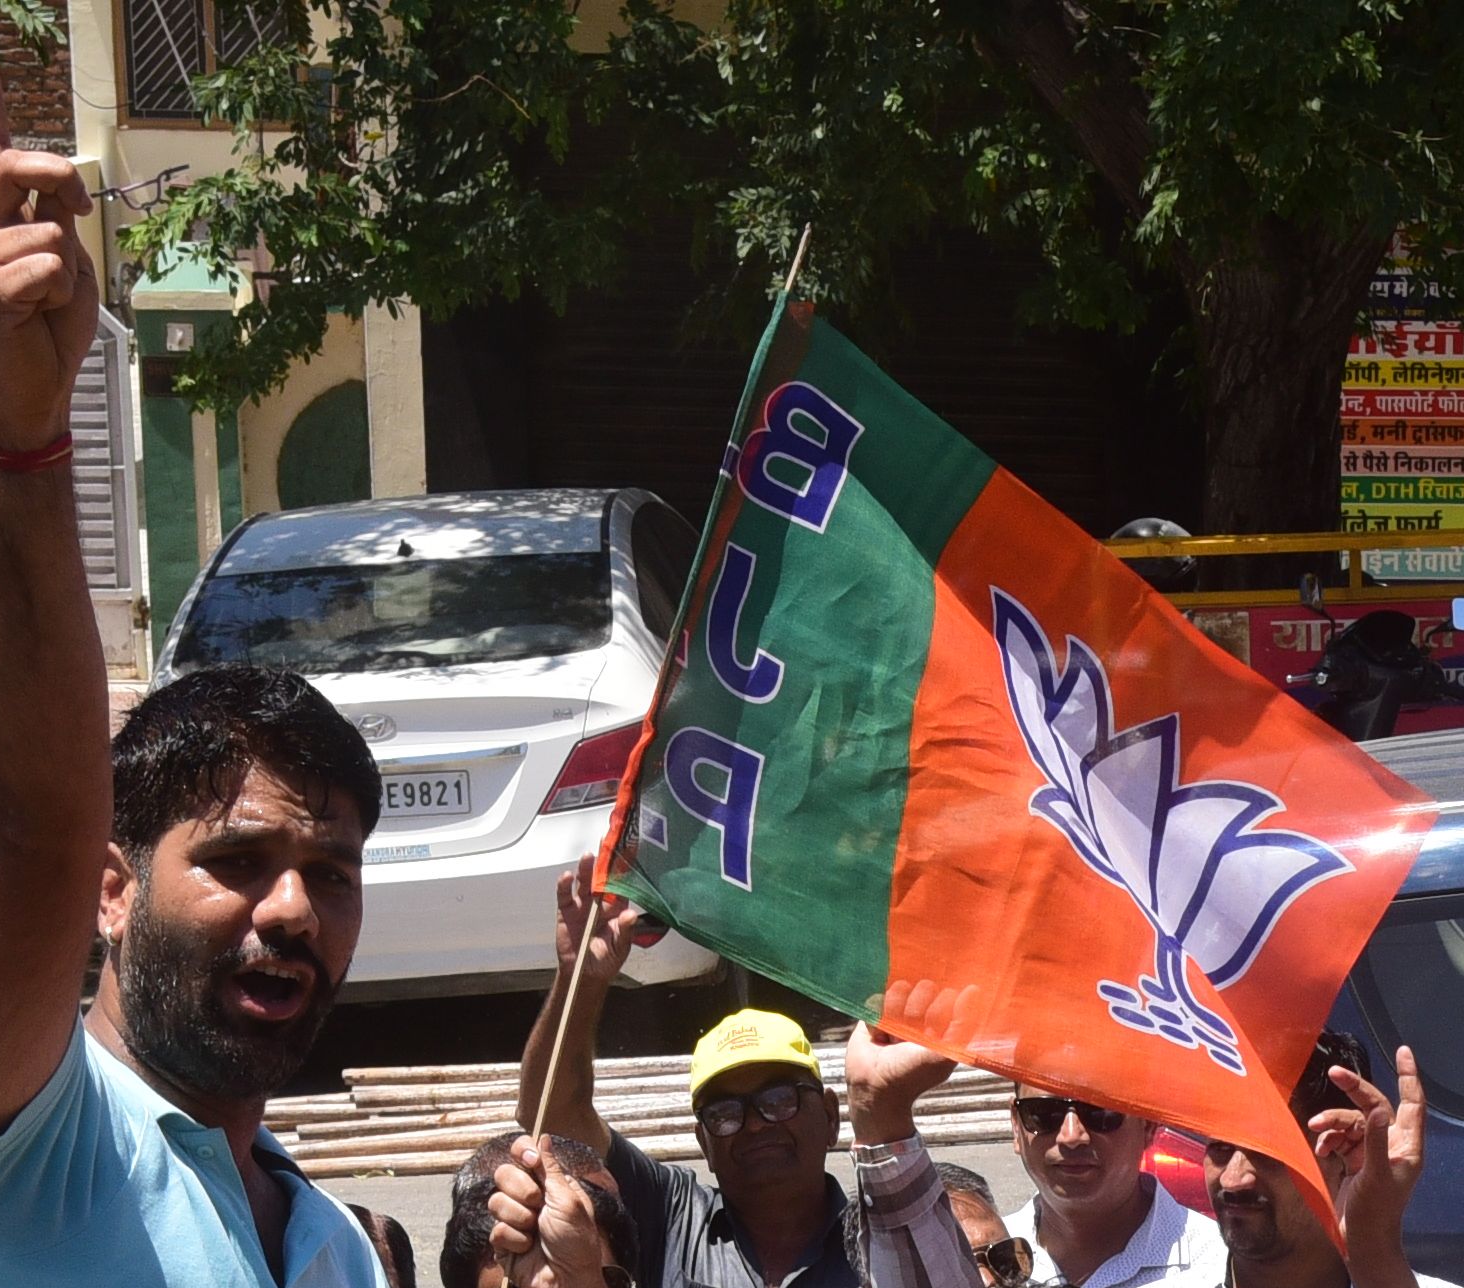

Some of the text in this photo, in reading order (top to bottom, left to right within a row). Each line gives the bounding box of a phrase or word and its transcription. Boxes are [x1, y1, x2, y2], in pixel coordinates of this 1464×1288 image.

[1376, 392, 1435, 413] पासपोर्ट
[1372, 420, 1408, 442] मनी
[1343, 451, 1359, 471] से
[1363, 450, 1389, 472] पैसे
[1372, 483, 1414, 499] DTH
[386, 779, 463, 809] E9821
